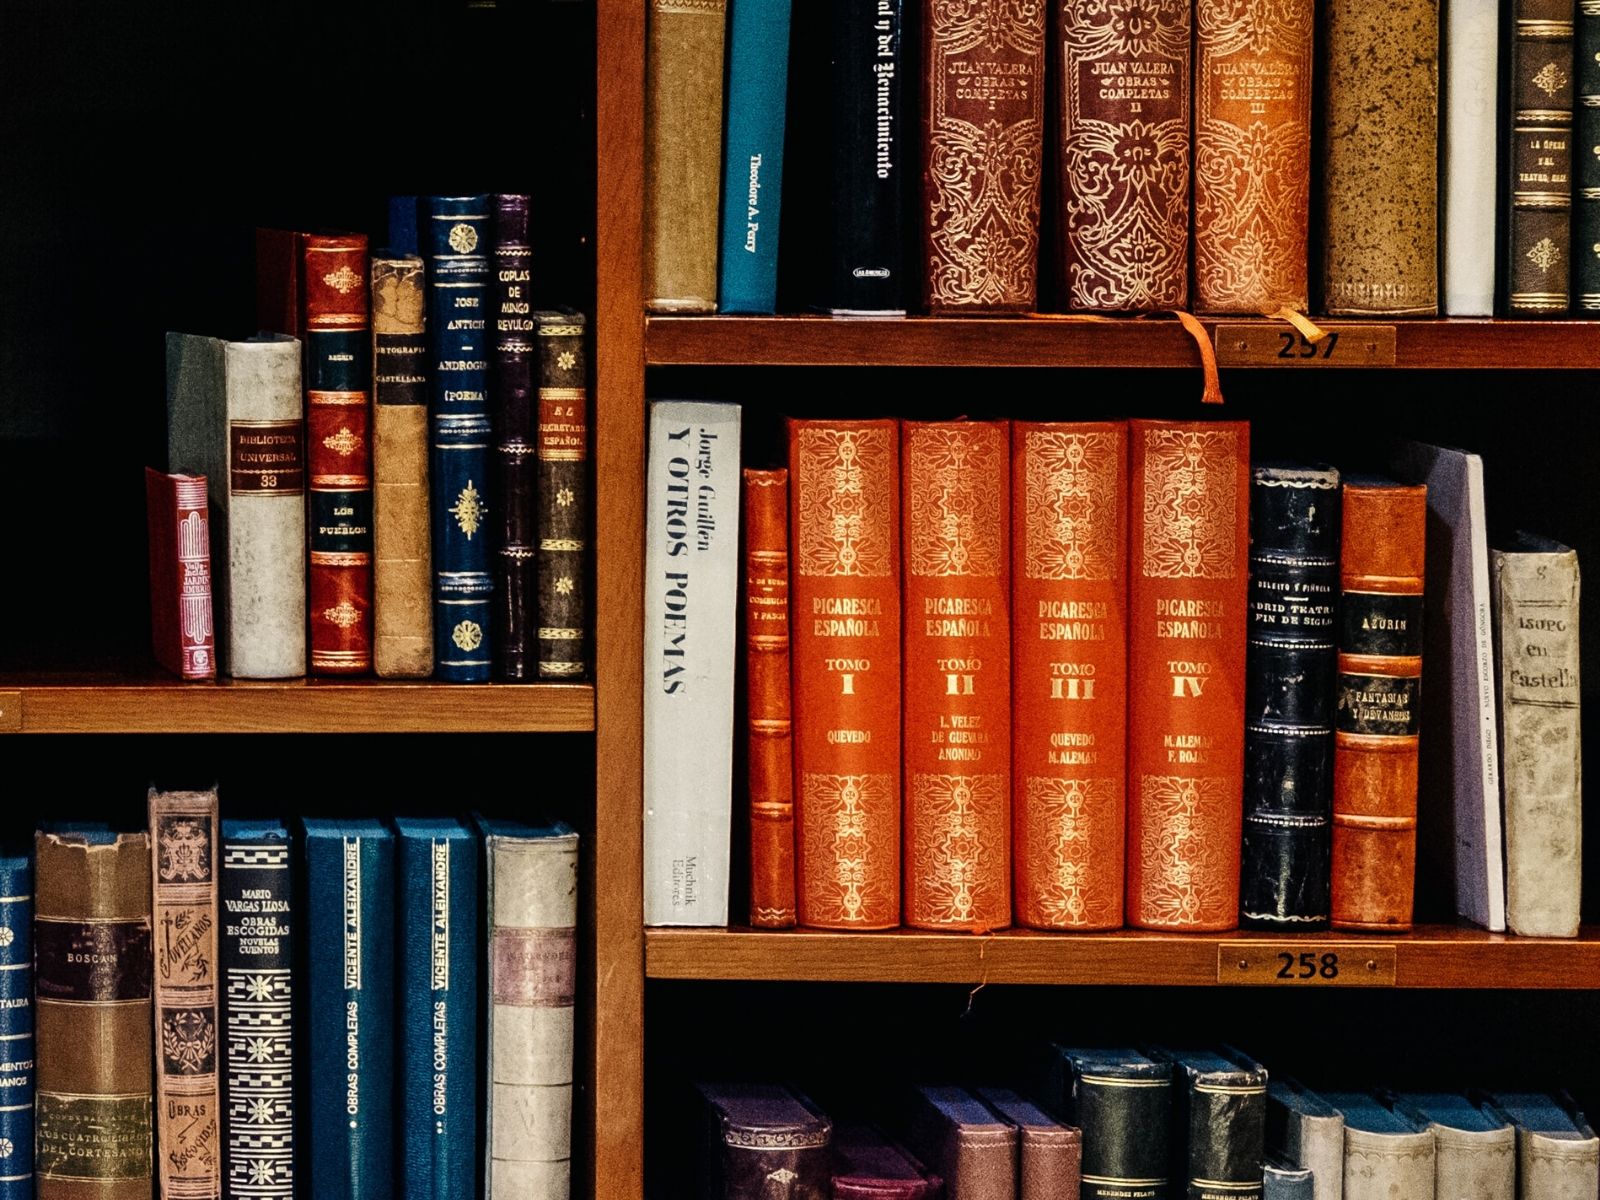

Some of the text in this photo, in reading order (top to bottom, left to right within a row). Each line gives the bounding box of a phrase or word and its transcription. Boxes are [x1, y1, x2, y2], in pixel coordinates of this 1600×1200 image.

[948, 62, 1033, 75] JUAN VALERA
[1091, 62, 1175, 75] JUAN VALERA
[1213, 62, 1300, 76] JUAN VALERA
[974, 77, 1015, 87] OBRAS
[1117, 77, 1157, 87] OBRAS
[1238, 77, 1281, 88] OBRAS
[955, 89, 1028, 100] COMPLETAS
[1099, 89, 1170, 100] COMPLETAS
[1220, 89, 1294, 100] COMPLETAS
[988, 101, 996, 110] I
[1130, 102, 1142, 113] II
[1250, 102, 1266, 113] III
[873, 62, 895, 179] Renacimiento
[744, 154, 762, 254] Theodore A. Perry
[499, 270, 530, 282] COPLAS
[508, 286, 521, 298] DE
[454, 298, 479, 308] JOSE
[501, 302, 530, 313] MINGO
[447, 320, 485, 330] ANTICH
[497, 318, 534, 331] REVULGO
[239, 435, 296, 445] BIBLIOTECA
[240, 452, 297, 463] UNIVERSAL
[260, 475, 278, 487] 33
[694, 427, 718, 551] Jorge Guillén
[334, 507, 354, 516] LOS
[663, 426, 691, 694] Y OTROS POEMAS
[813, 597, 882, 615] PICARESCA
[925, 597, 993, 616] PICARESCA
[1039, 600, 1108, 619] PICARESCA
[1156, 598, 1225, 617] PICARESCA
[1255, 613, 1299, 625] FIN DE
[814, 617, 880, 637] ESPAÑOLA
[926, 618, 991, 638] ESPAÑOLA
[1039, 621, 1105, 641] ESPAÑOLA
[1157, 620, 1223, 639] ESPAÑOLA
[825, 658, 871, 671] TOMO
[937, 658, 982, 672] TOMO
[1050, 662, 1096, 676] TOMO
[1167, 660, 1212, 675] TOMO
[840, 673, 855, 695] I
[945, 673, 976, 696] II
[1050, 678, 1096, 701] III
[1172, 676, 1209, 698] IV
[1355, 691, 1409, 705] FANTASIAS
[940, 715, 982, 728] L. VELEZ
[827, 730, 871, 744] QUEVEDO
[931, 731, 945, 744] DE
[1050, 732, 1095, 747] QUEVEDO
[671, 858, 685, 907] Editores
[685, 855, 697, 907] Muchnik
[241, 889, 272, 899] MARIO
[225, 900, 290, 912] VARGAS LLOSA
[241, 917, 276, 926] OBRAS
[346, 842, 358, 989] VICENTE ALEIXANDRE
[434, 843, 446, 989] VICENTE ALEIXANDRE
[227, 926, 290, 936] ESCOGIDAS
[239, 938, 279, 946] NOVELAS
[239, 946, 280, 954] CUENTOS
[1276, 952, 1340, 979] 258
[347, 1001, 358, 1115] OBRAS COMPLETAS
[433, 1001, 445, 1115] OBRAS COMPLETAS
[168, 1099, 206, 1120] OBRAS
